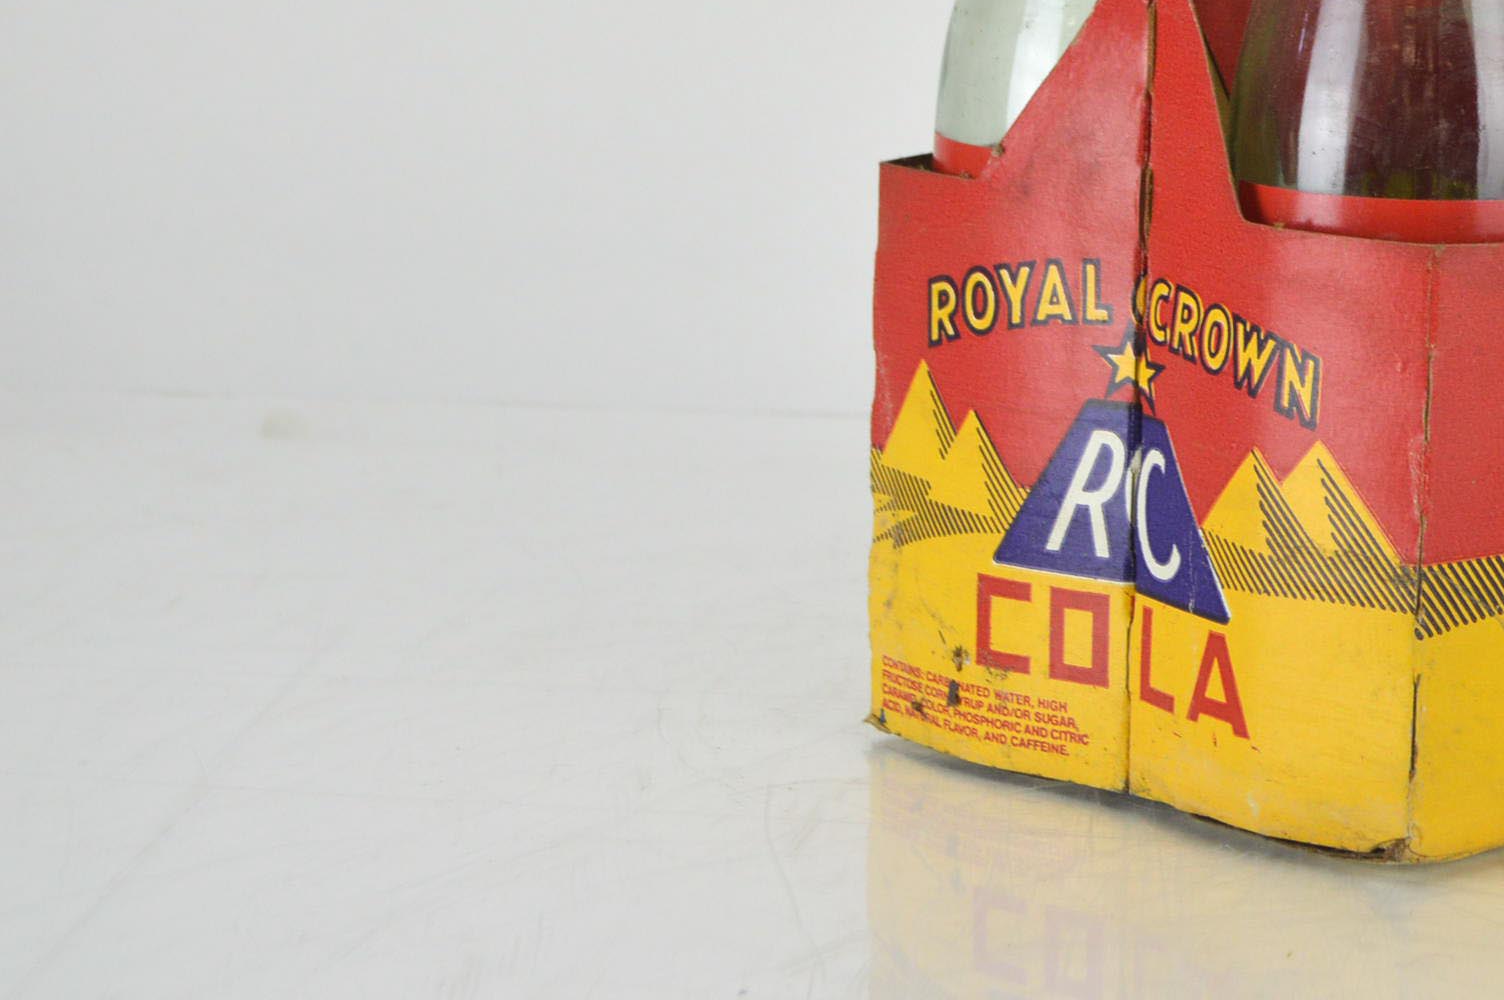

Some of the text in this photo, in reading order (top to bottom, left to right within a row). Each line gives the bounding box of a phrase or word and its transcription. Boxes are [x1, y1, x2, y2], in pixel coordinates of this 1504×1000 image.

[928, 258, 1322, 432] ROYAL CROWN
[1045, 429, 1181, 580] RC
[974, 572, 1251, 741] COLA
[926, 671, 990, 698] CARBNATED
[994, 690, 1034, 709] WATER,
[1038, 697, 1068, 713] HIGH
[953, 706, 1021, 733] PHOSPHORIC
[1024, 724, 1048, 739] AND
[1050, 728, 1090, 746] CITRIC
[984, 731, 1007, 745] AND
[987, 703, 1032, 721] AND/OR
[1034, 711, 1080, 731] SUGAR,
